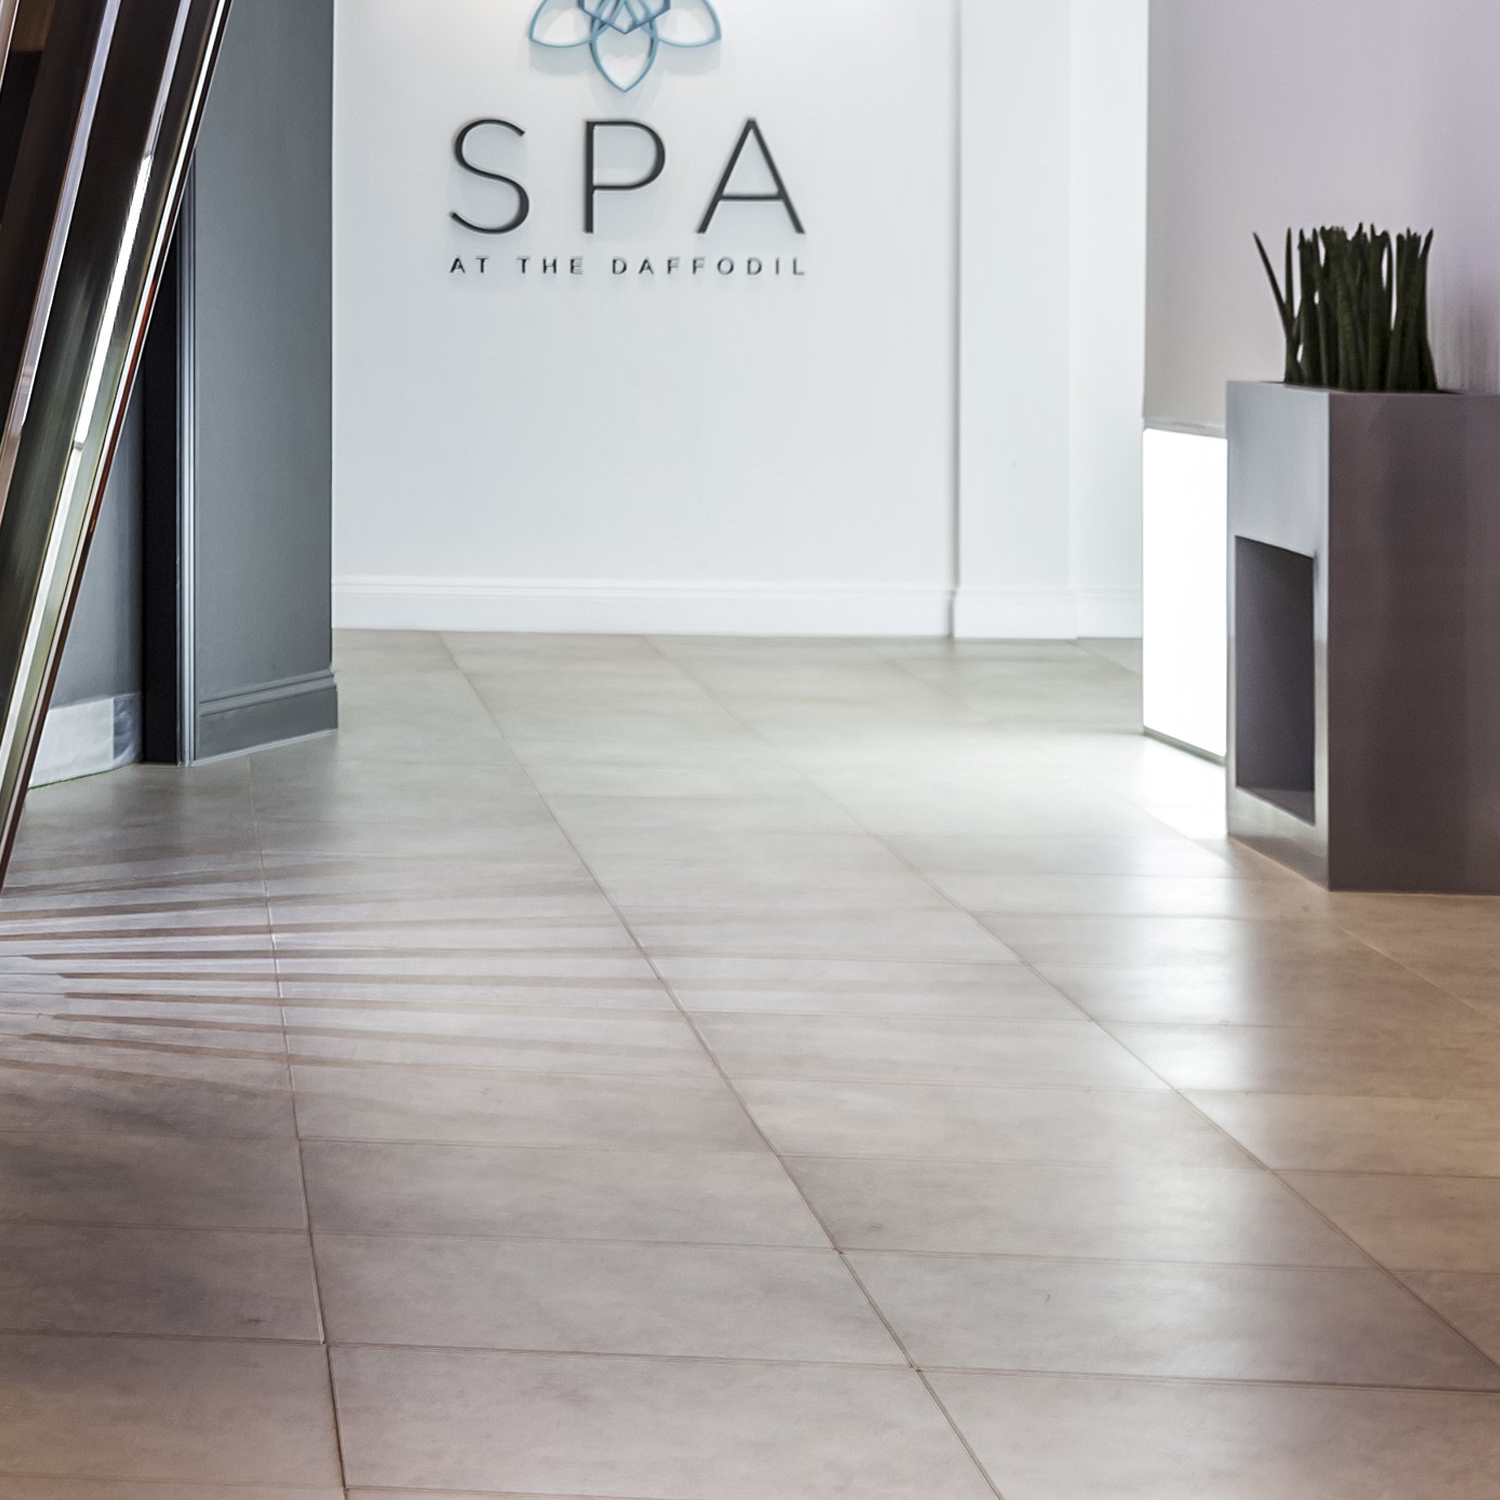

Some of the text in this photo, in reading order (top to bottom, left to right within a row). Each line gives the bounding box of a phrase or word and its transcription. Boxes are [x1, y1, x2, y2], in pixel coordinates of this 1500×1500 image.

[449, 117, 806, 235] SPA
[449, 256, 806, 277] AT THE DAFFODIL
